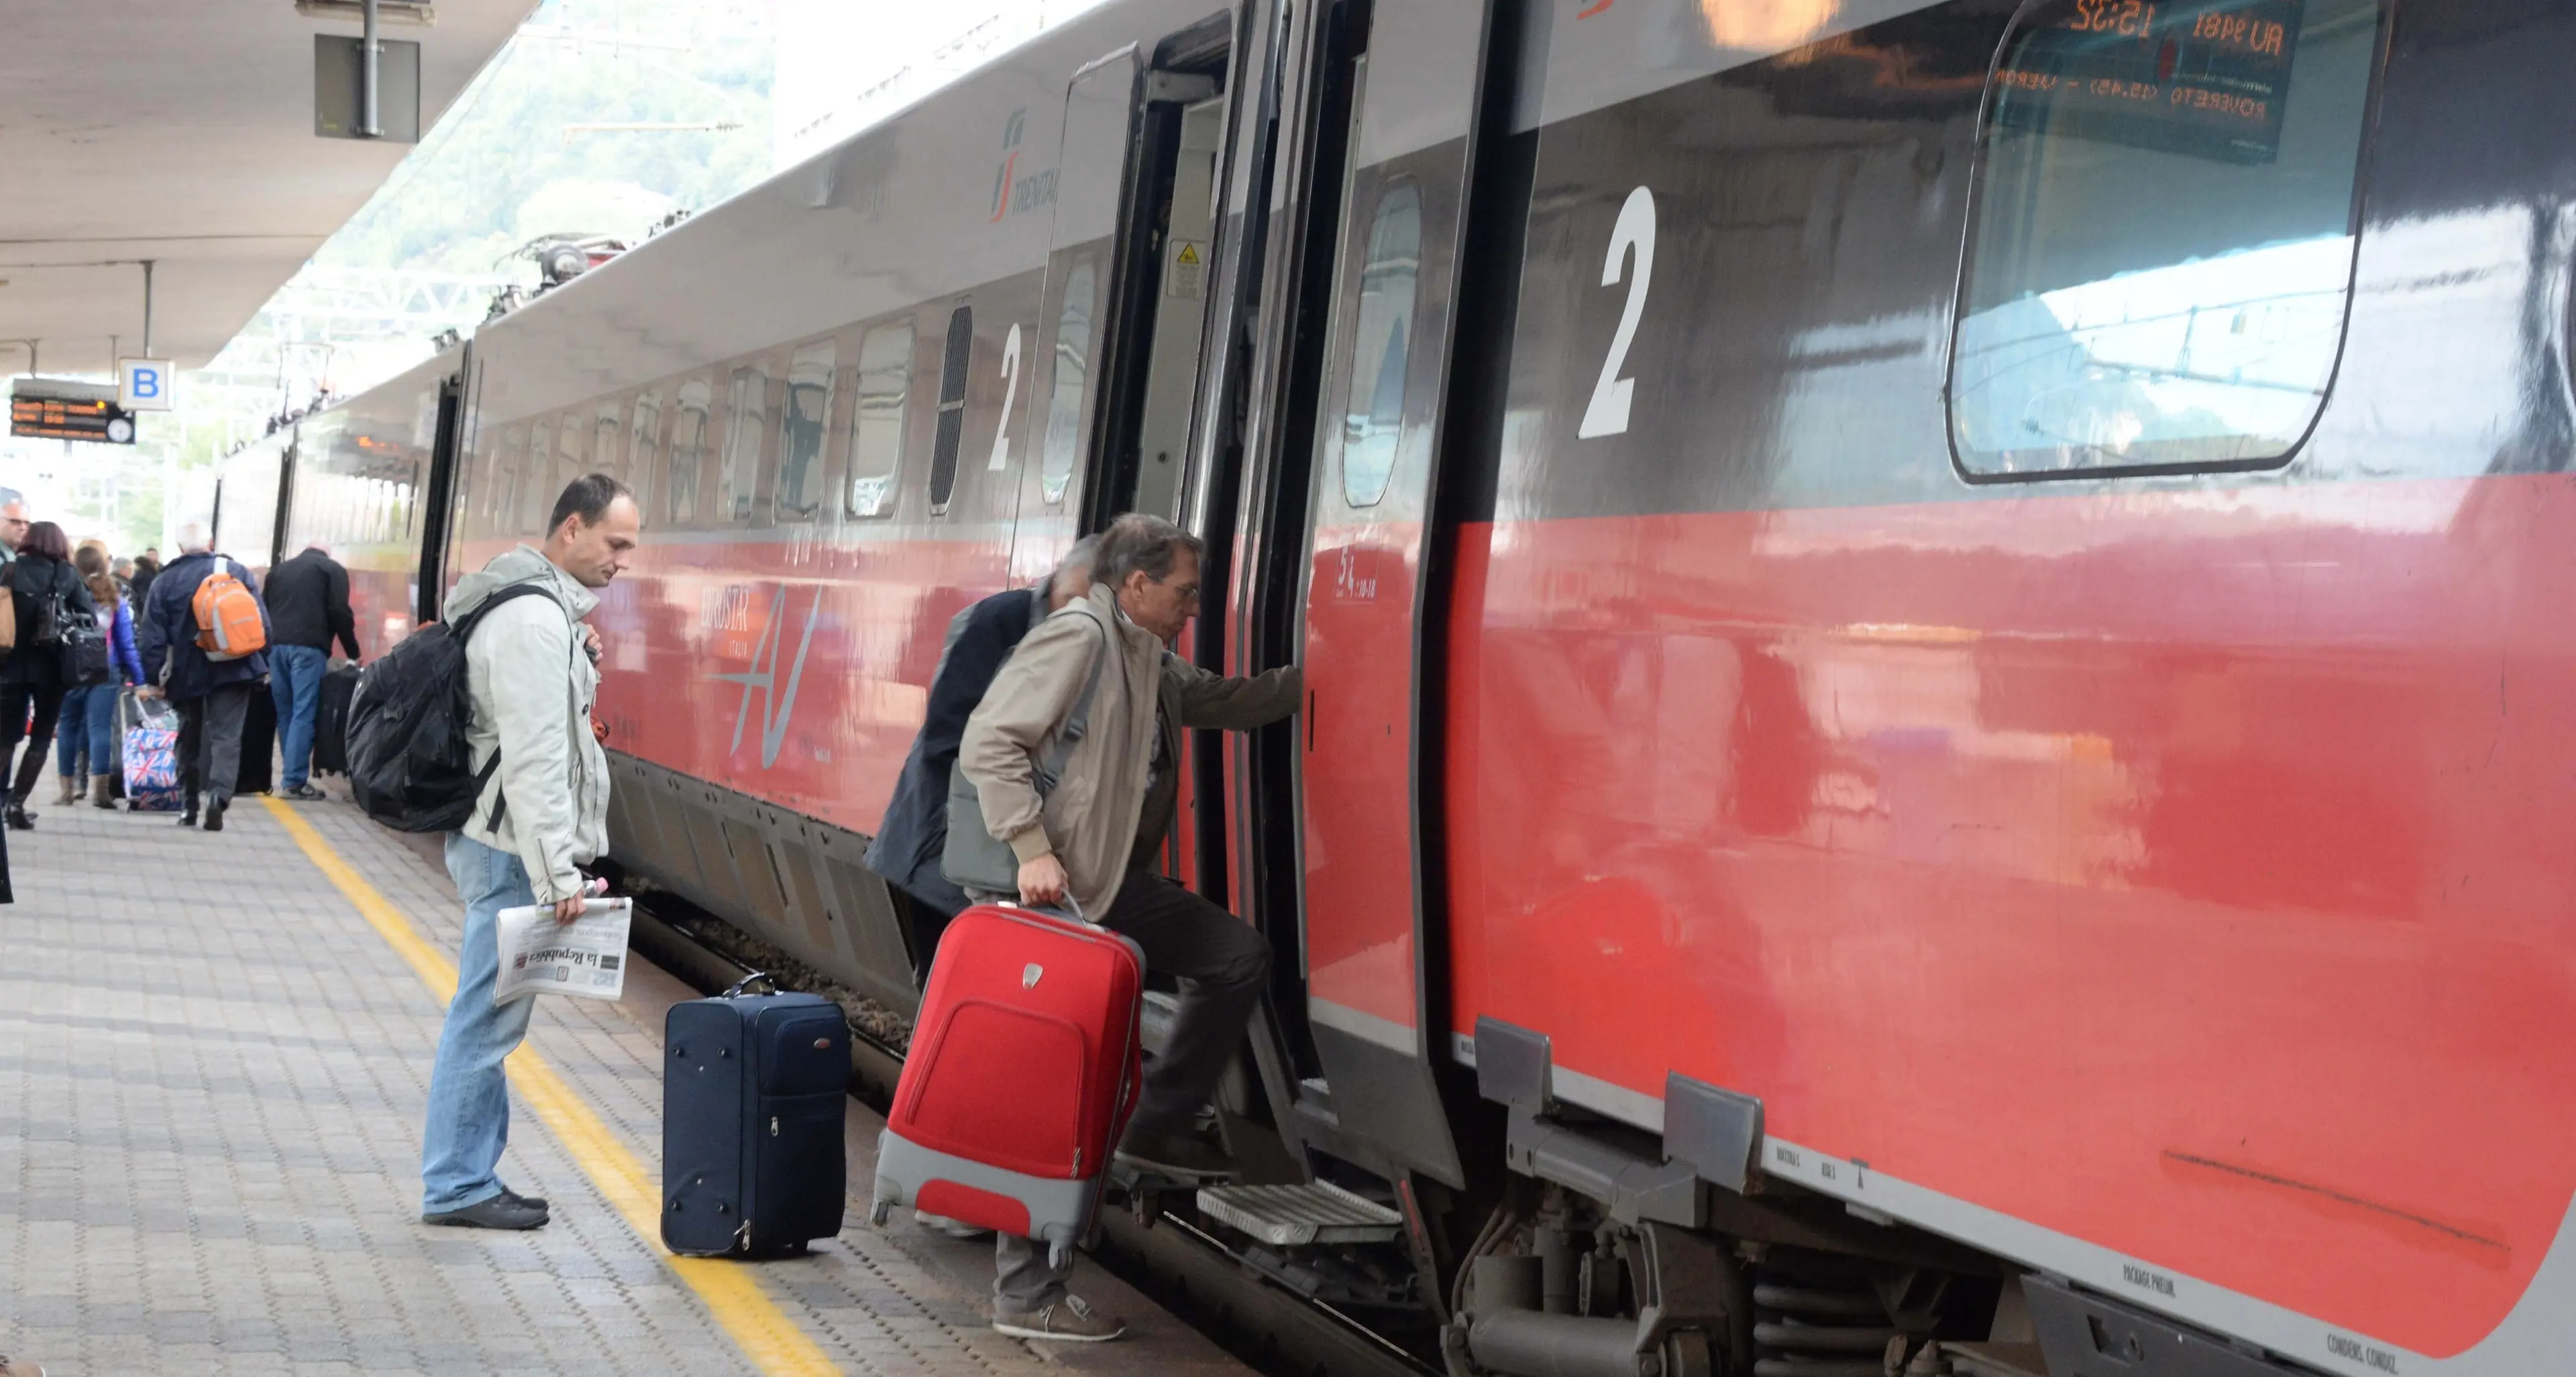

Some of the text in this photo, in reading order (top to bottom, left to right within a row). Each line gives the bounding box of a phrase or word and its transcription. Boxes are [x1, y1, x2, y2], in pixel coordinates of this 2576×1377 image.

[1578, 185, 1656, 439] 2
[133, 368, 159, 398] B
[988, 323, 1021, 471] 2
[700, 586, 749, 632] EUROSTAR
[528, 947, 598, 967] la Repubblica
